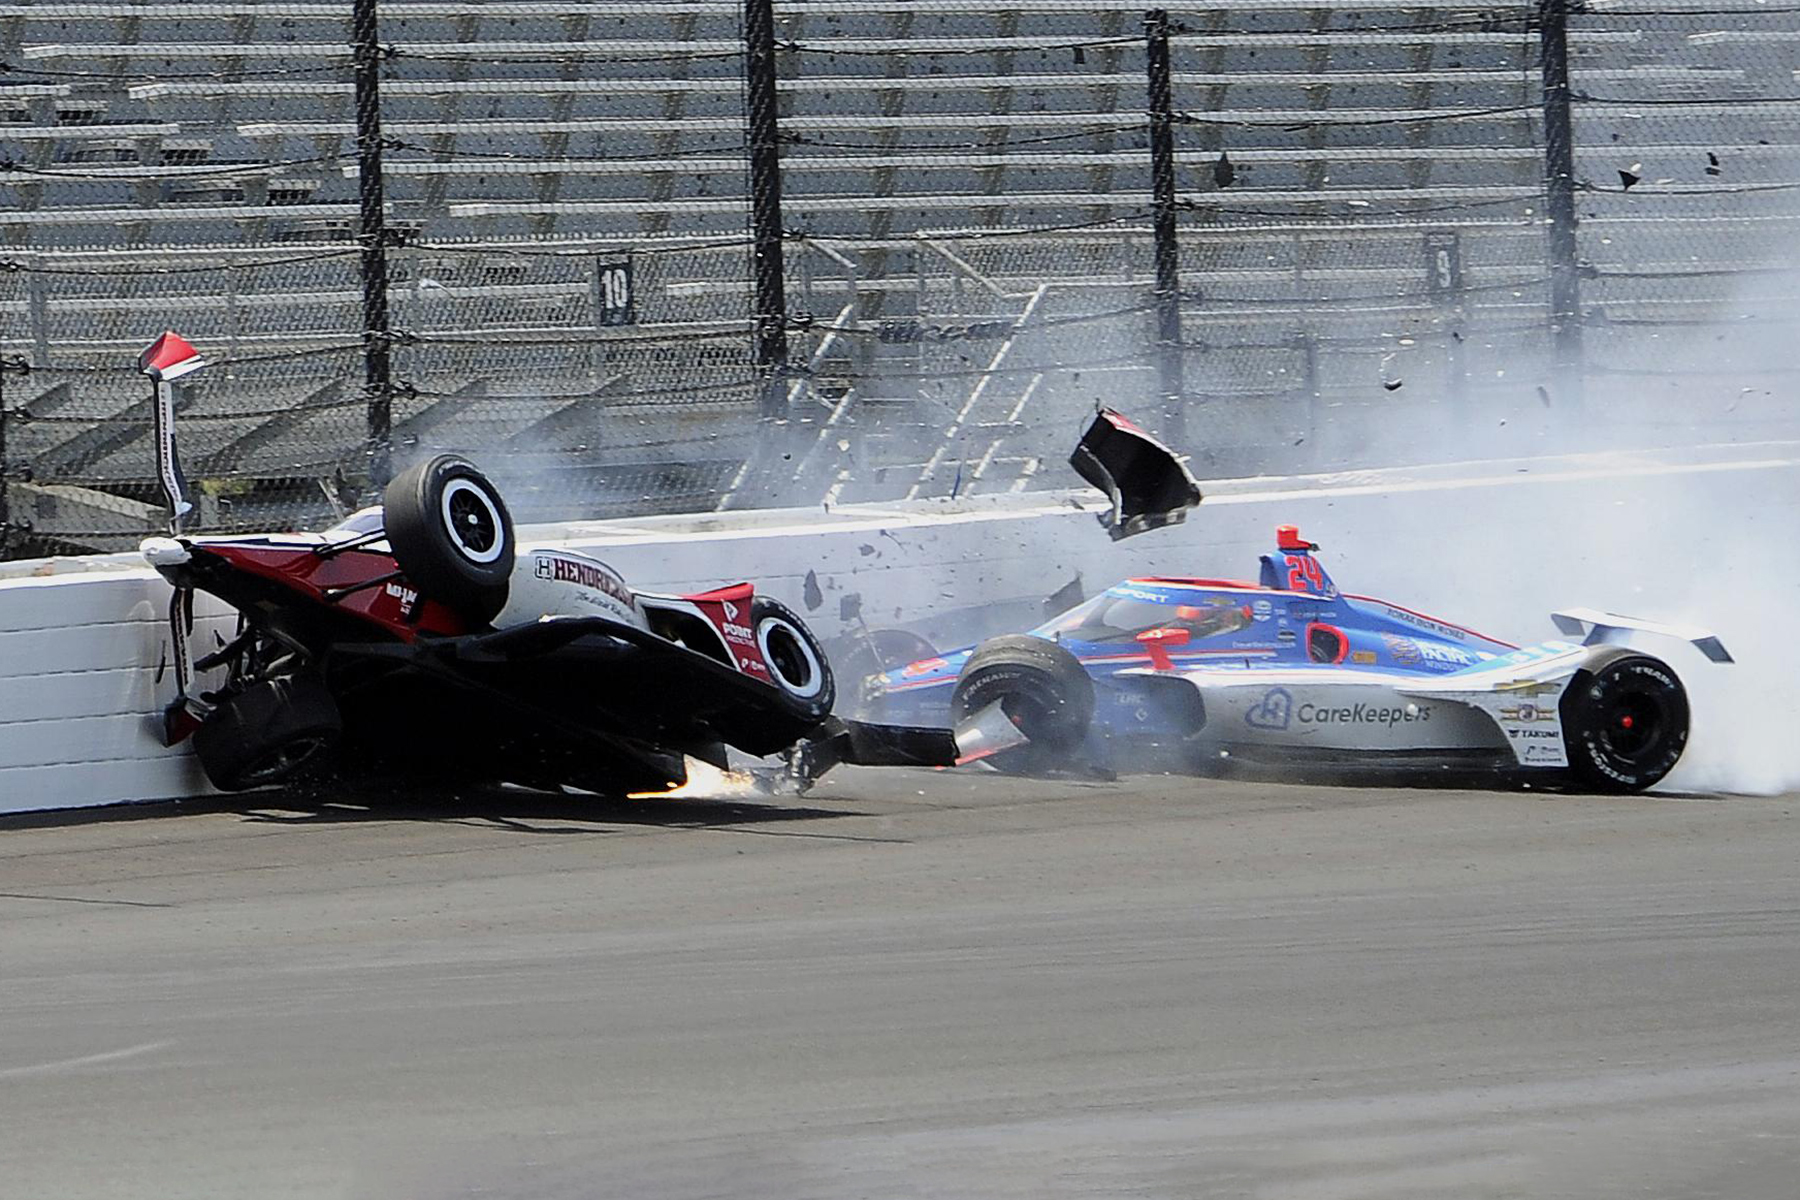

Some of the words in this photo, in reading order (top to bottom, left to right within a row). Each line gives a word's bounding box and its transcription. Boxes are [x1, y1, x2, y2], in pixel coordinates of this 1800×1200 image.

[1437, 251, 1451, 288] 9
[601, 268, 627, 309] 10
[1283, 555, 1324, 591] 24
